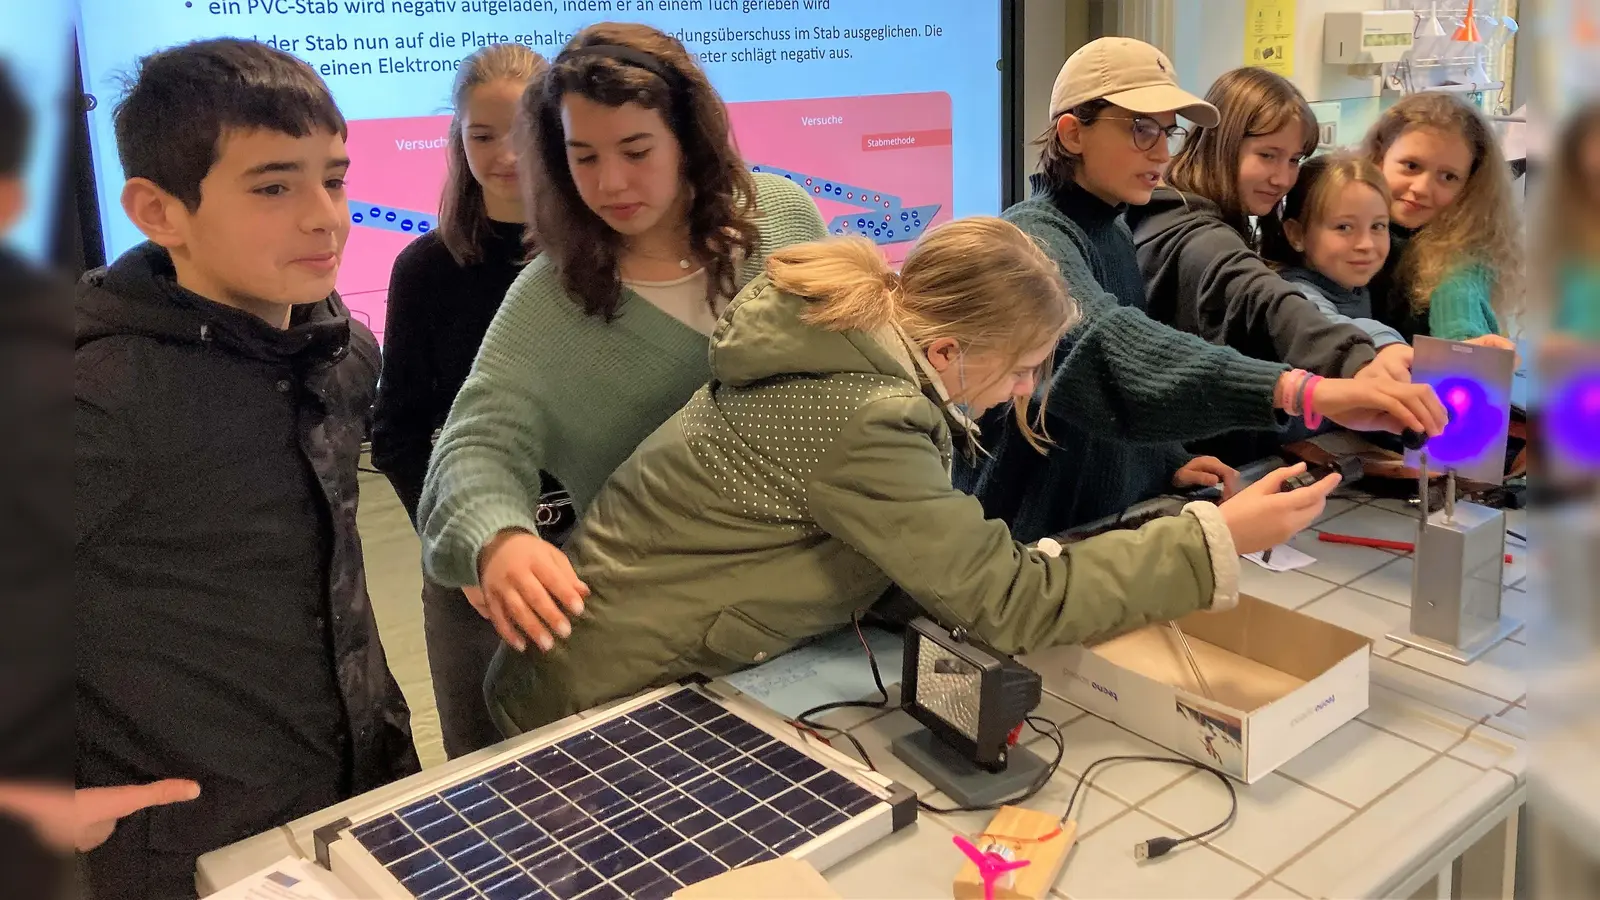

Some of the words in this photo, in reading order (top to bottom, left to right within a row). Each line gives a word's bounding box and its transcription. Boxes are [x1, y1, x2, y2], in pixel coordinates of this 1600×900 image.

[209, 0, 240, 14] ein
[248, 0, 338, 14] PVC-Stab
[345, 0, 385, 13] wird
[392, 0, 456, 16] negativ
[461, 0, 558, 17] aufgeladen,
[563, 0, 612, 11] indem
[616, 0, 632, 11] er
[637, 0, 654, 11] an
[659, 0, 702, 11] einem
[742, 0, 799, 13] gerieben
[804, 0, 830, 10] wird
[267, 34, 299, 51] der
[306, 34, 348, 51] Stab
[354, 36, 389, 50] nun
[395, 33, 423, 49] auf
[429, 32, 455, 48] die
[462, 31, 509, 47] Platte
[515, 30, 572, 46] gehalte
[795, 27, 810, 40] im
[813, 26, 840, 40] Stab
[844, 25, 921, 41] ausgeglichen.
[925, 24, 943, 37] Die
[320, 62, 372, 76] einen
[379, 57, 461, 74] Elektrone
[731, 48, 777, 64] schlägt
[780, 47, 825, 63] negativ
[829, 48, 853, 60] aus.
[801, 115, 843, 126] Versuche
[395, 136, 449, 151] Versuch
[867, 136, 915, 148] Stabmethode
